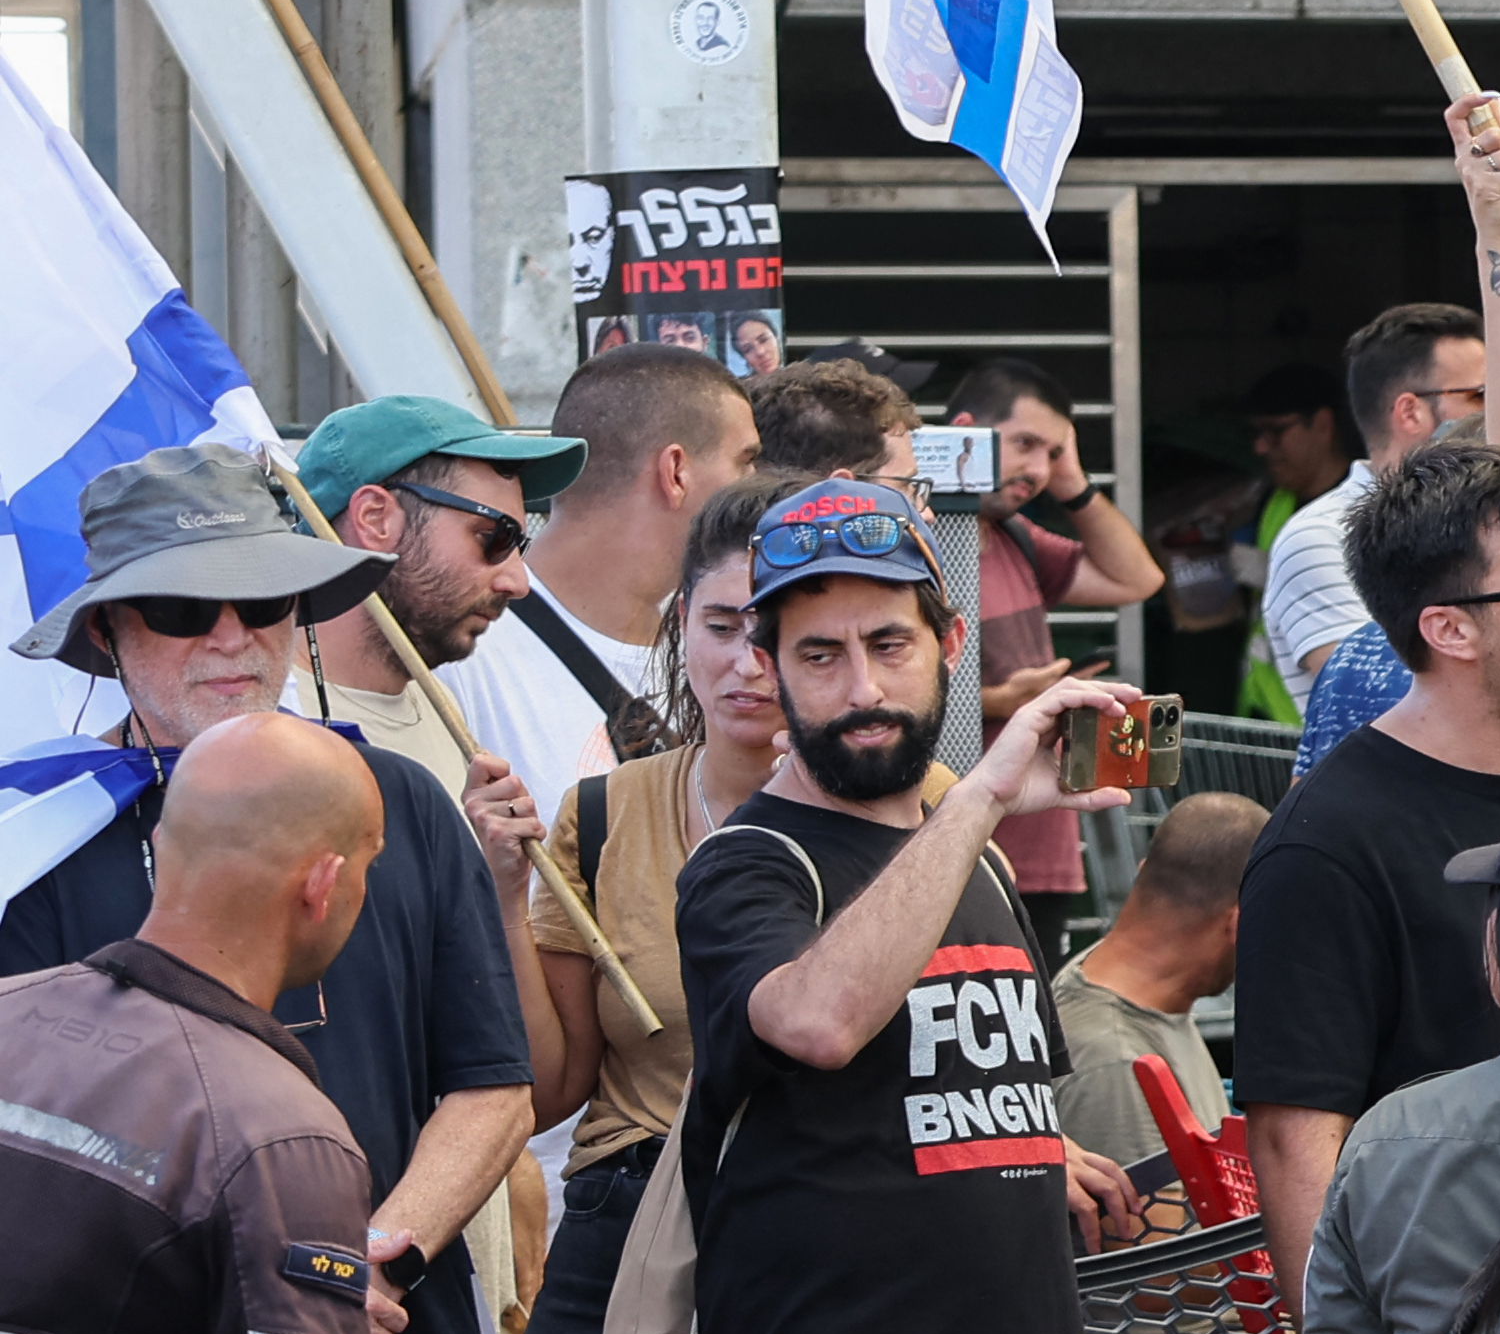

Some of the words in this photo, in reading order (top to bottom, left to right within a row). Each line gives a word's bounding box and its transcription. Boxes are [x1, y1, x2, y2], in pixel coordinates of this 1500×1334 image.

[616, 183, 781, 258] בגללך
[621, 258, 729, 295] נרצחו
[737, 257, 783, 290] הם
[906, 977, 1051, 1078] FCK
